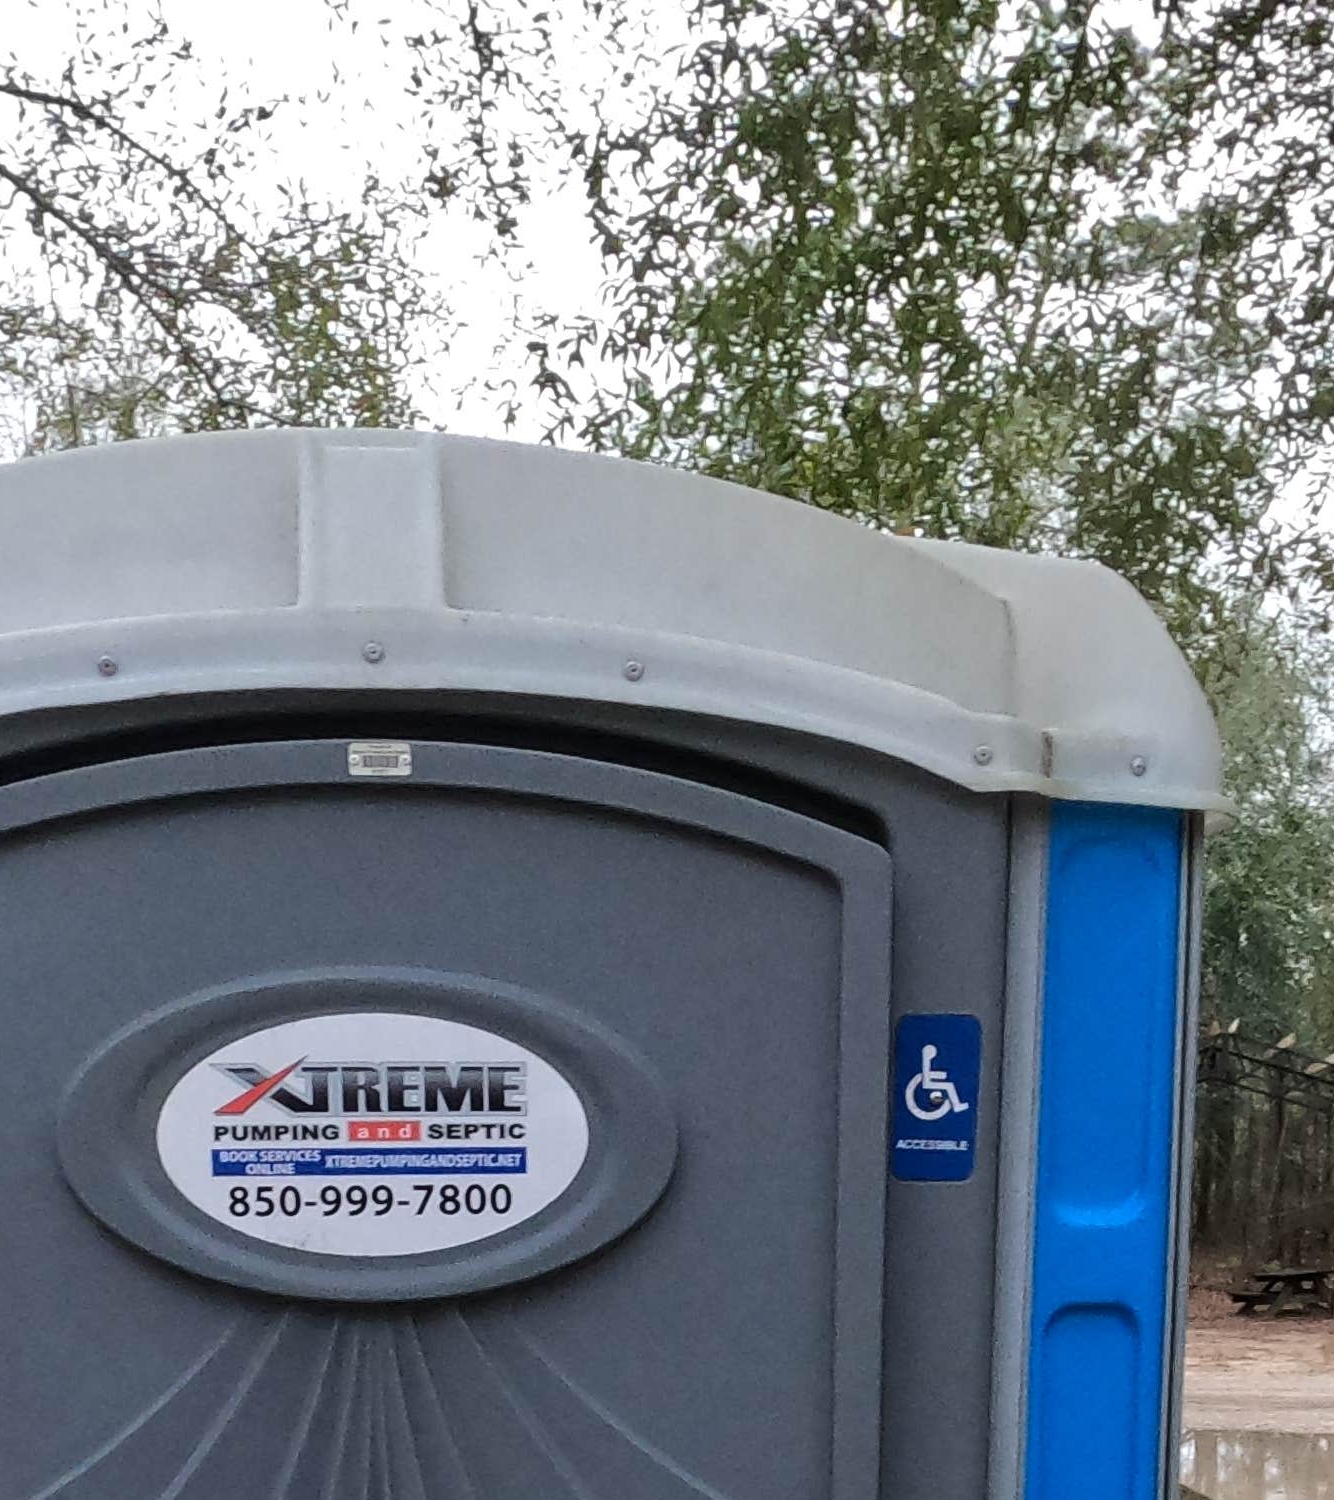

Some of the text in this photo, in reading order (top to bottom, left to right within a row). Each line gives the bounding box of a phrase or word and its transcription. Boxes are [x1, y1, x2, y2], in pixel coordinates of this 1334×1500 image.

[209, 1055, 528, 1118] XTREME
[213, 1122, 527, 1142] PUMPING and SEPTIC
[219, 1150, 322, 1163] BOOK SERVICES
[324, 1153, 523, 1169] XTREMEPUMPINGANDSEPTIC.NET
[245, 1163, 296, 1175] ONLINE
[228, 1183, 513, 1217] 850-999-7800
